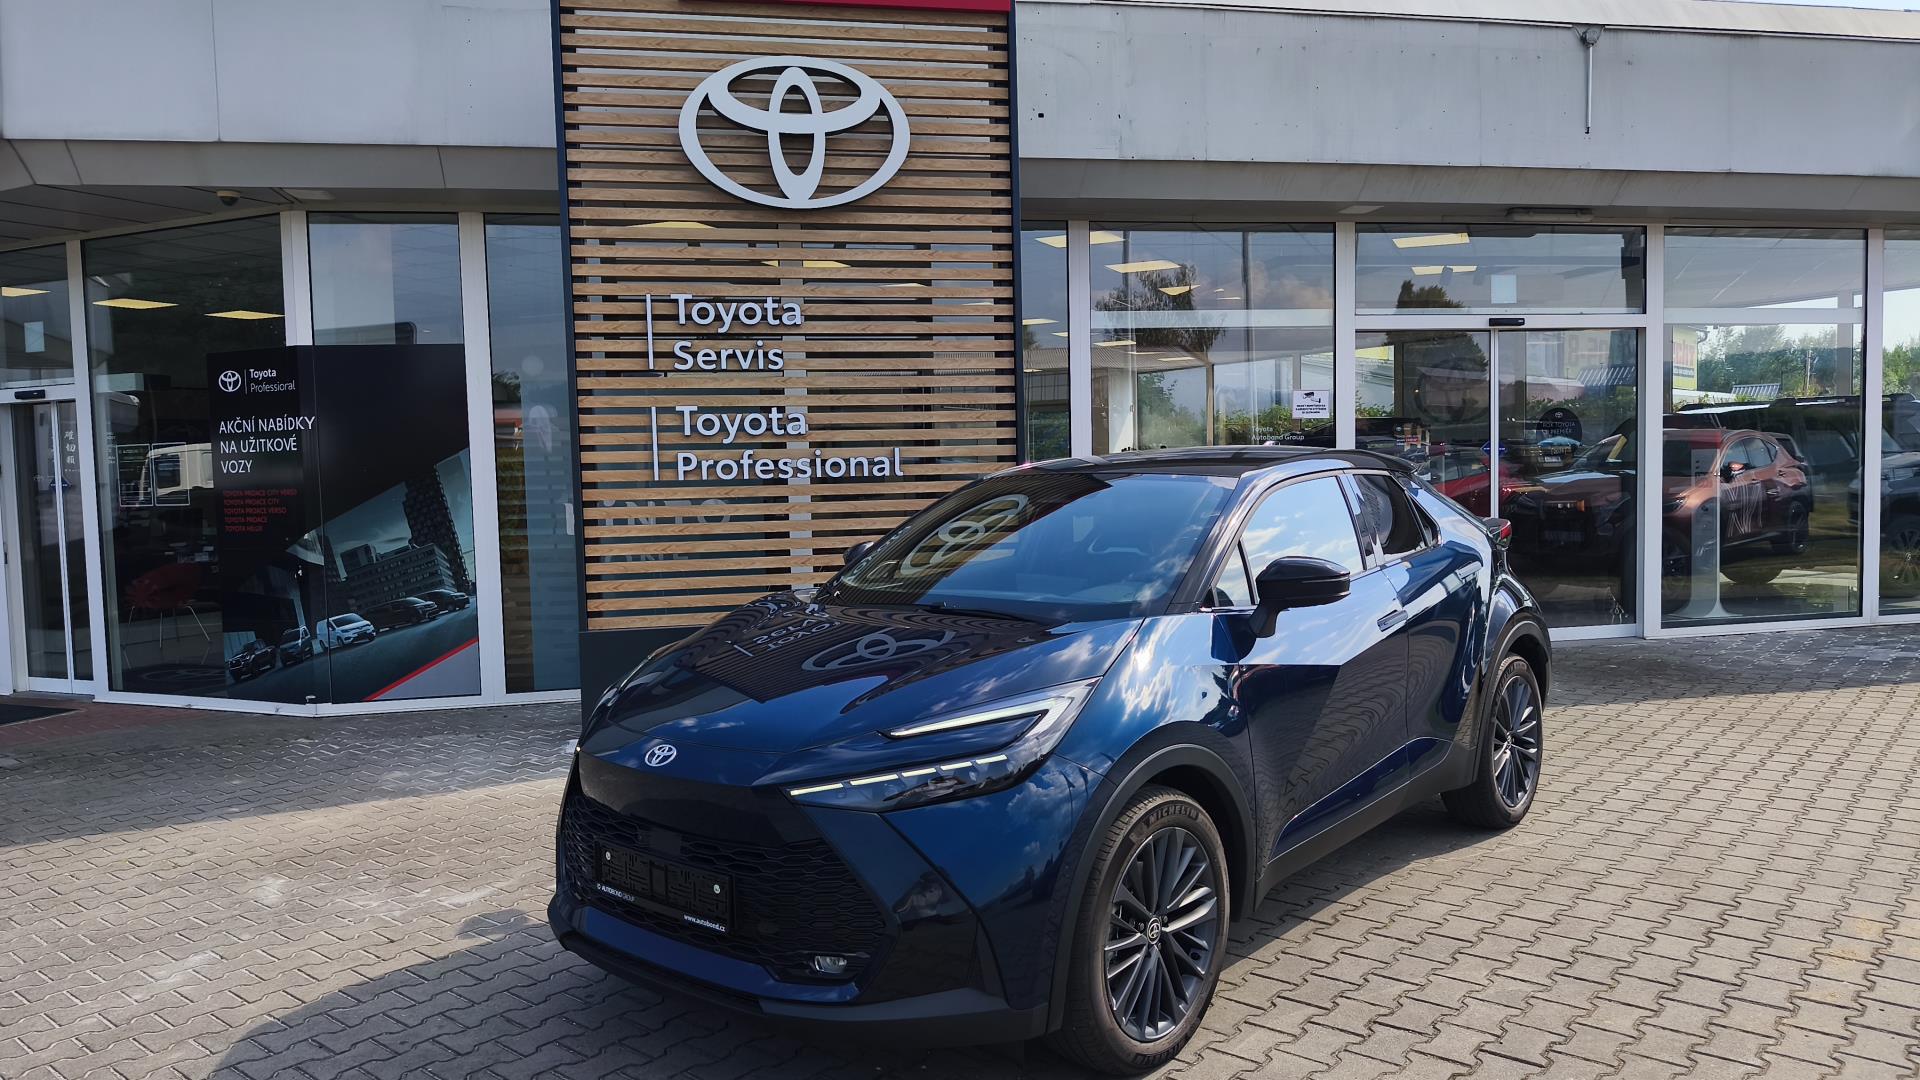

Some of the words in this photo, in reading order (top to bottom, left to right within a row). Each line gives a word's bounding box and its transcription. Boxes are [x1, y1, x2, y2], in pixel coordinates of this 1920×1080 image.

[670, 293, 802, 334] Toyota
[673, 340, 785, 370] Servis
[248, 368, 277, 380] Toyota
[250, 380, 296, 393] Professional
[219, 415, 255, 434] AKČNÍ
[258, 413, 316, 433] NABÍDKY
[675, 405, 808, 444] Toyota
[220, 440, 238, 454] NA
[240, 433, 298, 453] UŽITKOVÉ
[1284, 434, 1305, 442] Group
[220, 459, 253, 474] VOZY
[677, 447, 904, 481] Professional
[1147, 803, 1200, 827] MICHELIN
